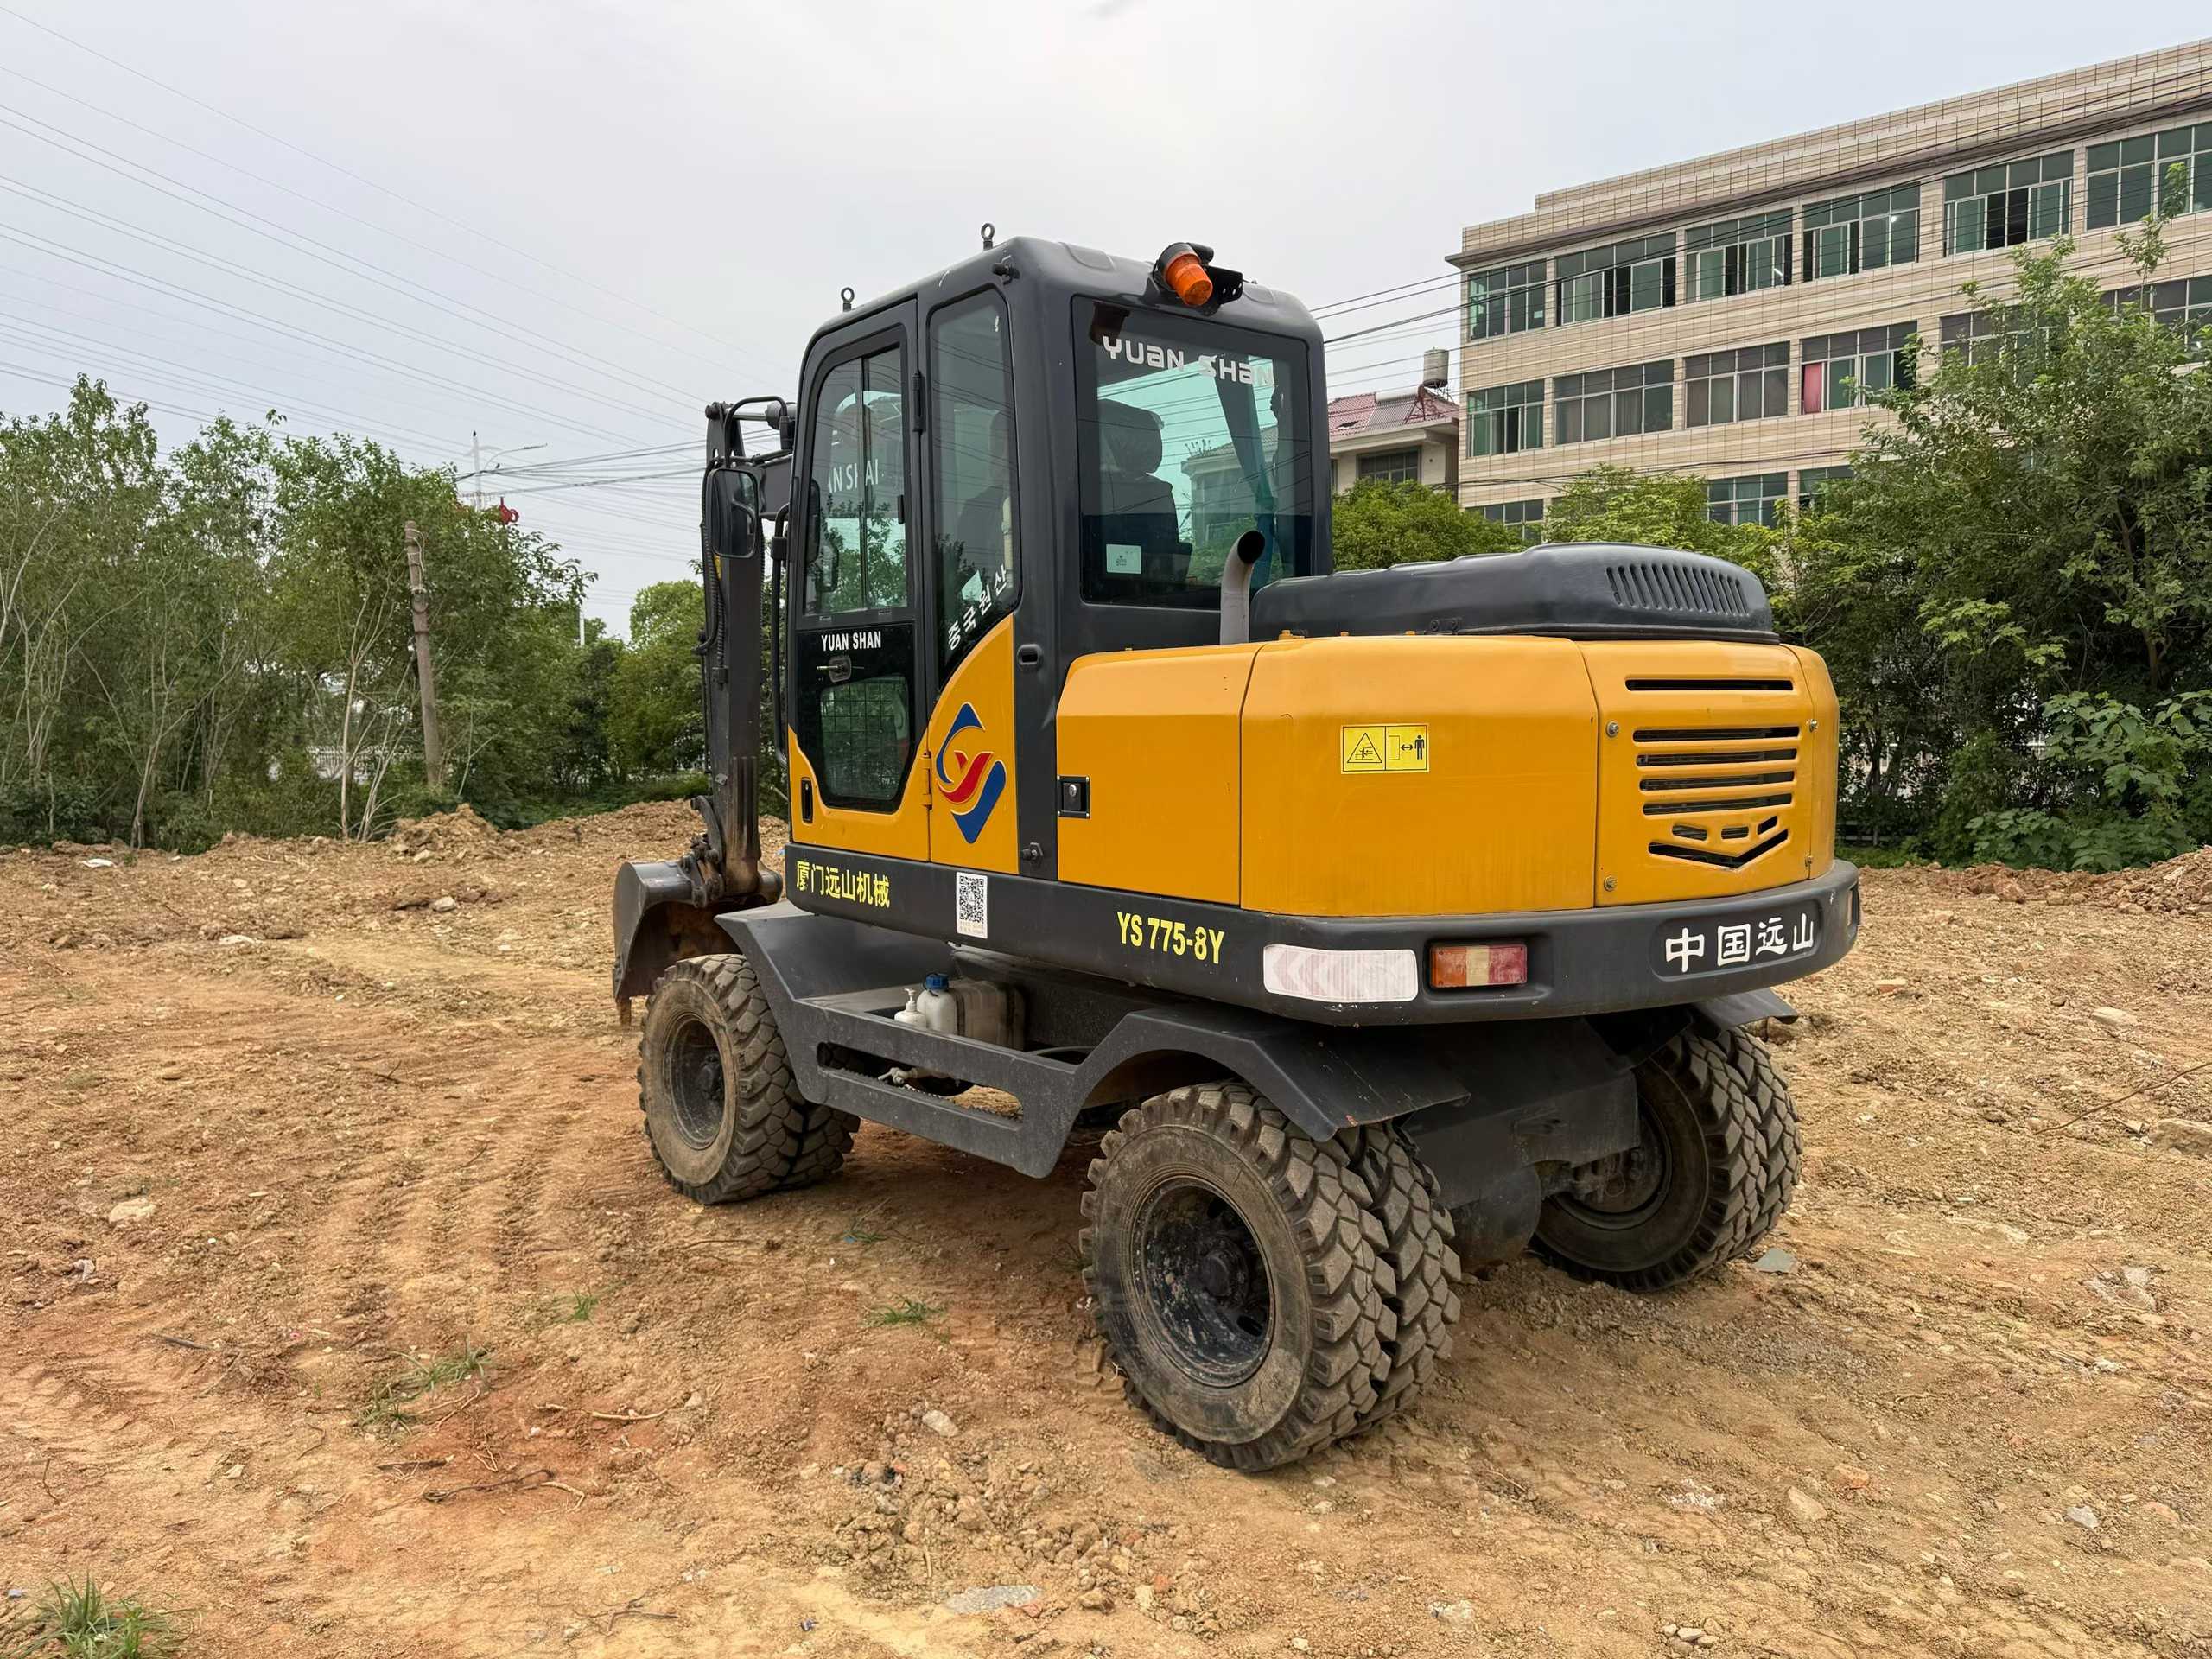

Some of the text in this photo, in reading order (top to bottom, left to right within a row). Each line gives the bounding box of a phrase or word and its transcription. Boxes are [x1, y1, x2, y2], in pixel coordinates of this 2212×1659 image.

[1103, 335, 1185, 372] YUAN
[948, 563, 1007, 651] 중국원산
[821, 630, 881, 652] YUAN SHAN
[797, 860, 890, 908] 厦门远山机械
[1116, 911, 1225, 964] YS 775-8Y
[1665, 912, 1814, 973] 中国远山
